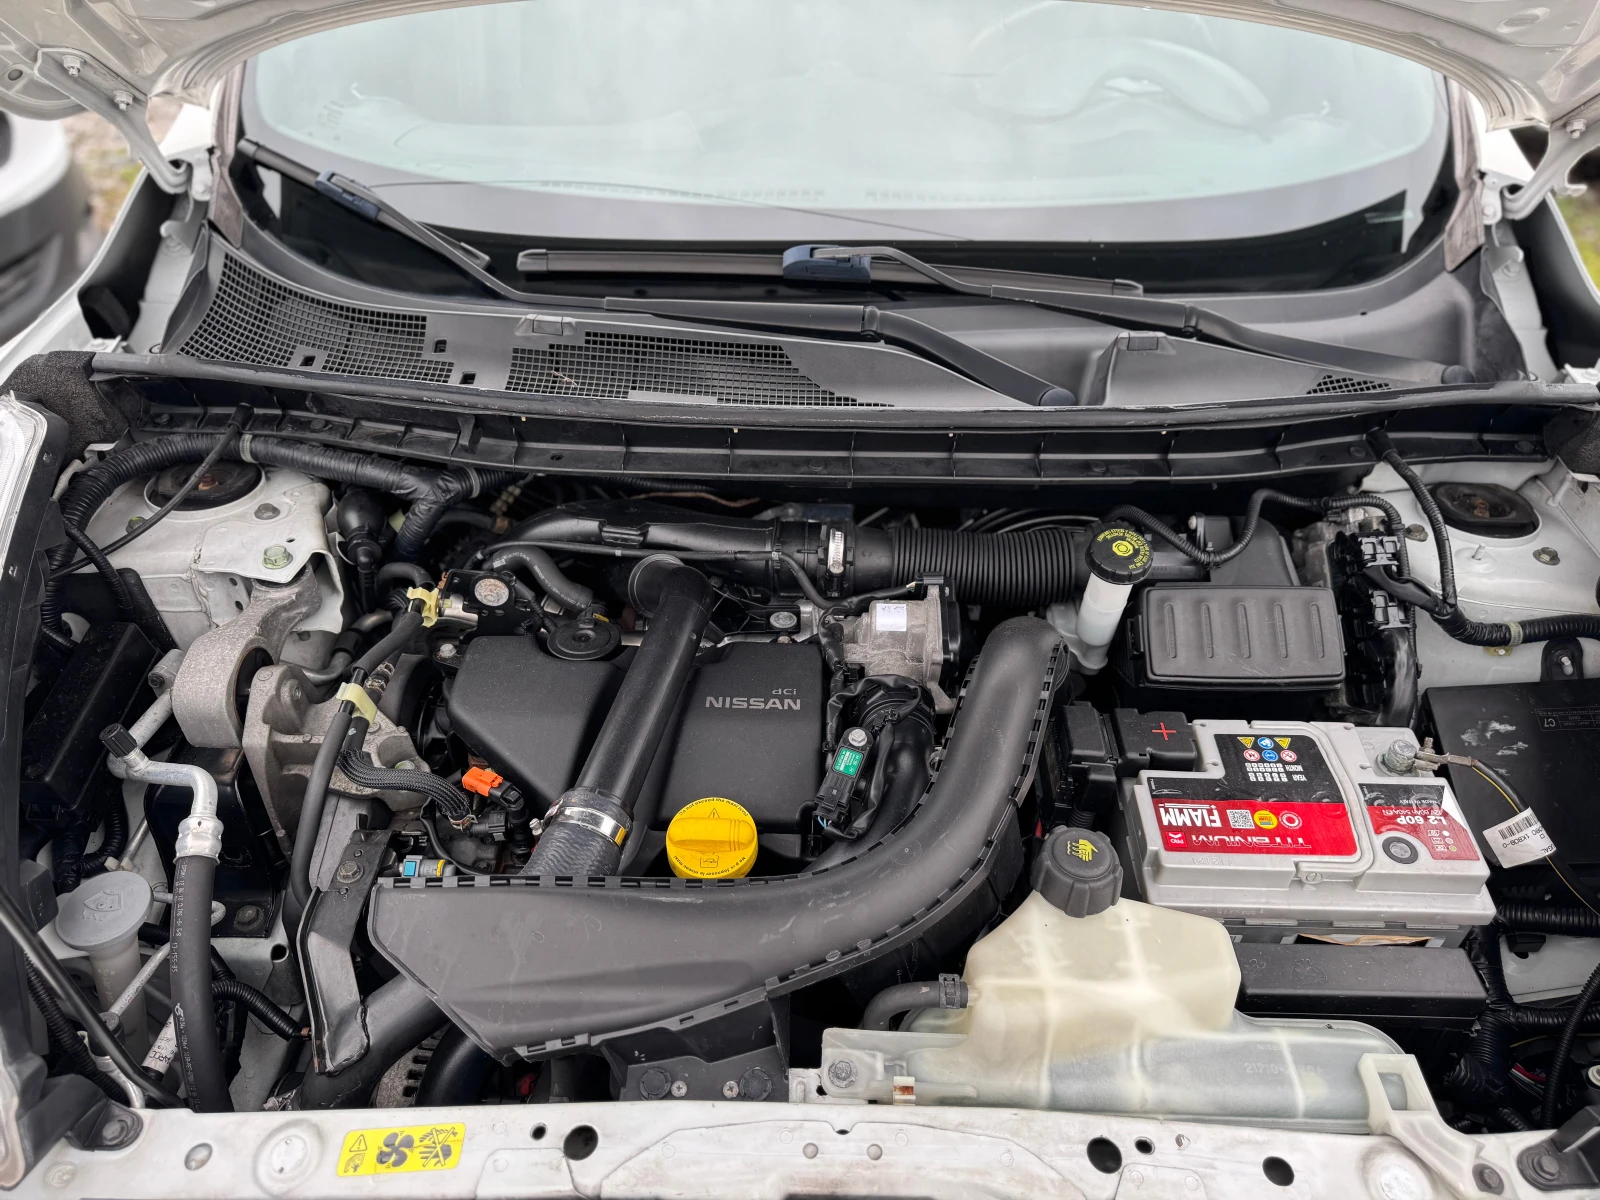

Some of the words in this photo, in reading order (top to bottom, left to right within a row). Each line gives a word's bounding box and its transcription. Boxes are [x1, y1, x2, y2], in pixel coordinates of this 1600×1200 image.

[705, 696, 800, 710] NISSAN
[1158, 807, 1222, 828] FIAMM
[1396, 816, 1424, 824] 60P
[1426, 816, 1447, 824] L2
[1191, 834, 1312, 848] TITANIUM
